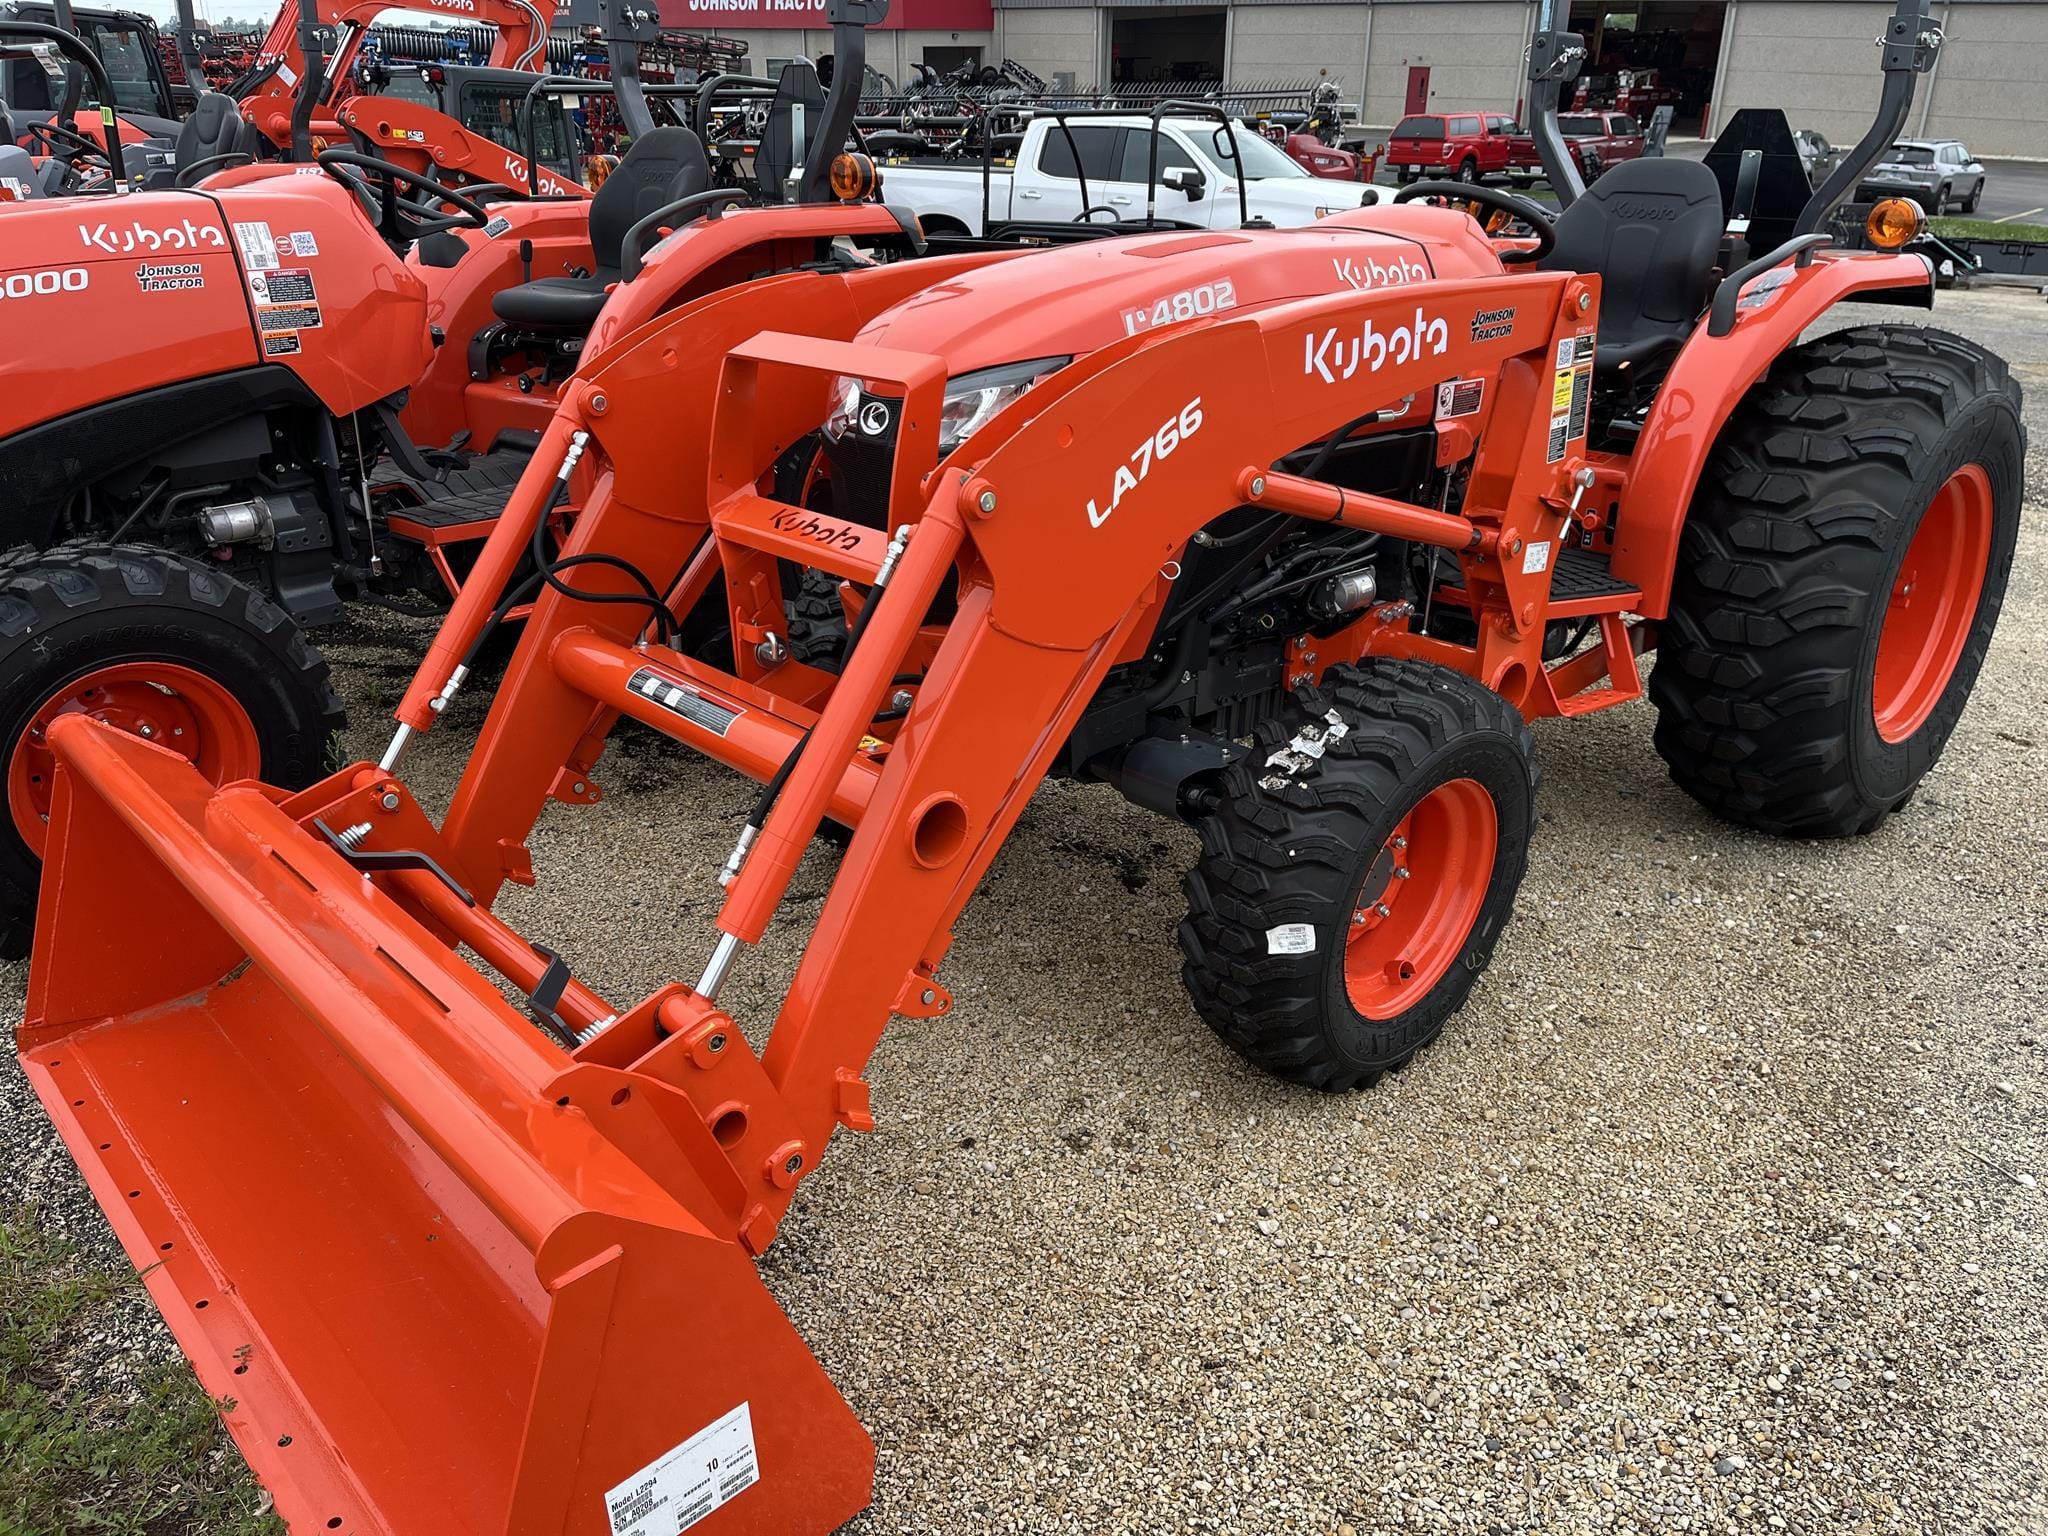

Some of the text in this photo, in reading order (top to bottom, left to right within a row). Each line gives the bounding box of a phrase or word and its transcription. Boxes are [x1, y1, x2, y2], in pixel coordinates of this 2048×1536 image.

[689, 0, 826, 11] JOHNSON TRACTO
[505, 155, 565, 196] Kuota
[78, 218, 225, 253] Kubota
[136, 263, 200, 278] JOHNSON
[1332, 255, 1427, 290] Kubota
[0, 268, 89, 300] 000
[139, 276, 204, 291] TRACTOR
[1471, 308, 1516, 327] JOHNSON
[1471, 324, 1513, 343] TRACTOR
[1305, 307, 1448, 384] Kubota
[1086, 396, 1203, 528] LA766
[769, 508, 861, 550] Kubota
[706, 1457, 719, 1472] 10
[611, 1492, 634, 1512] Model
[613, 1516, 627, 1530] S/N
